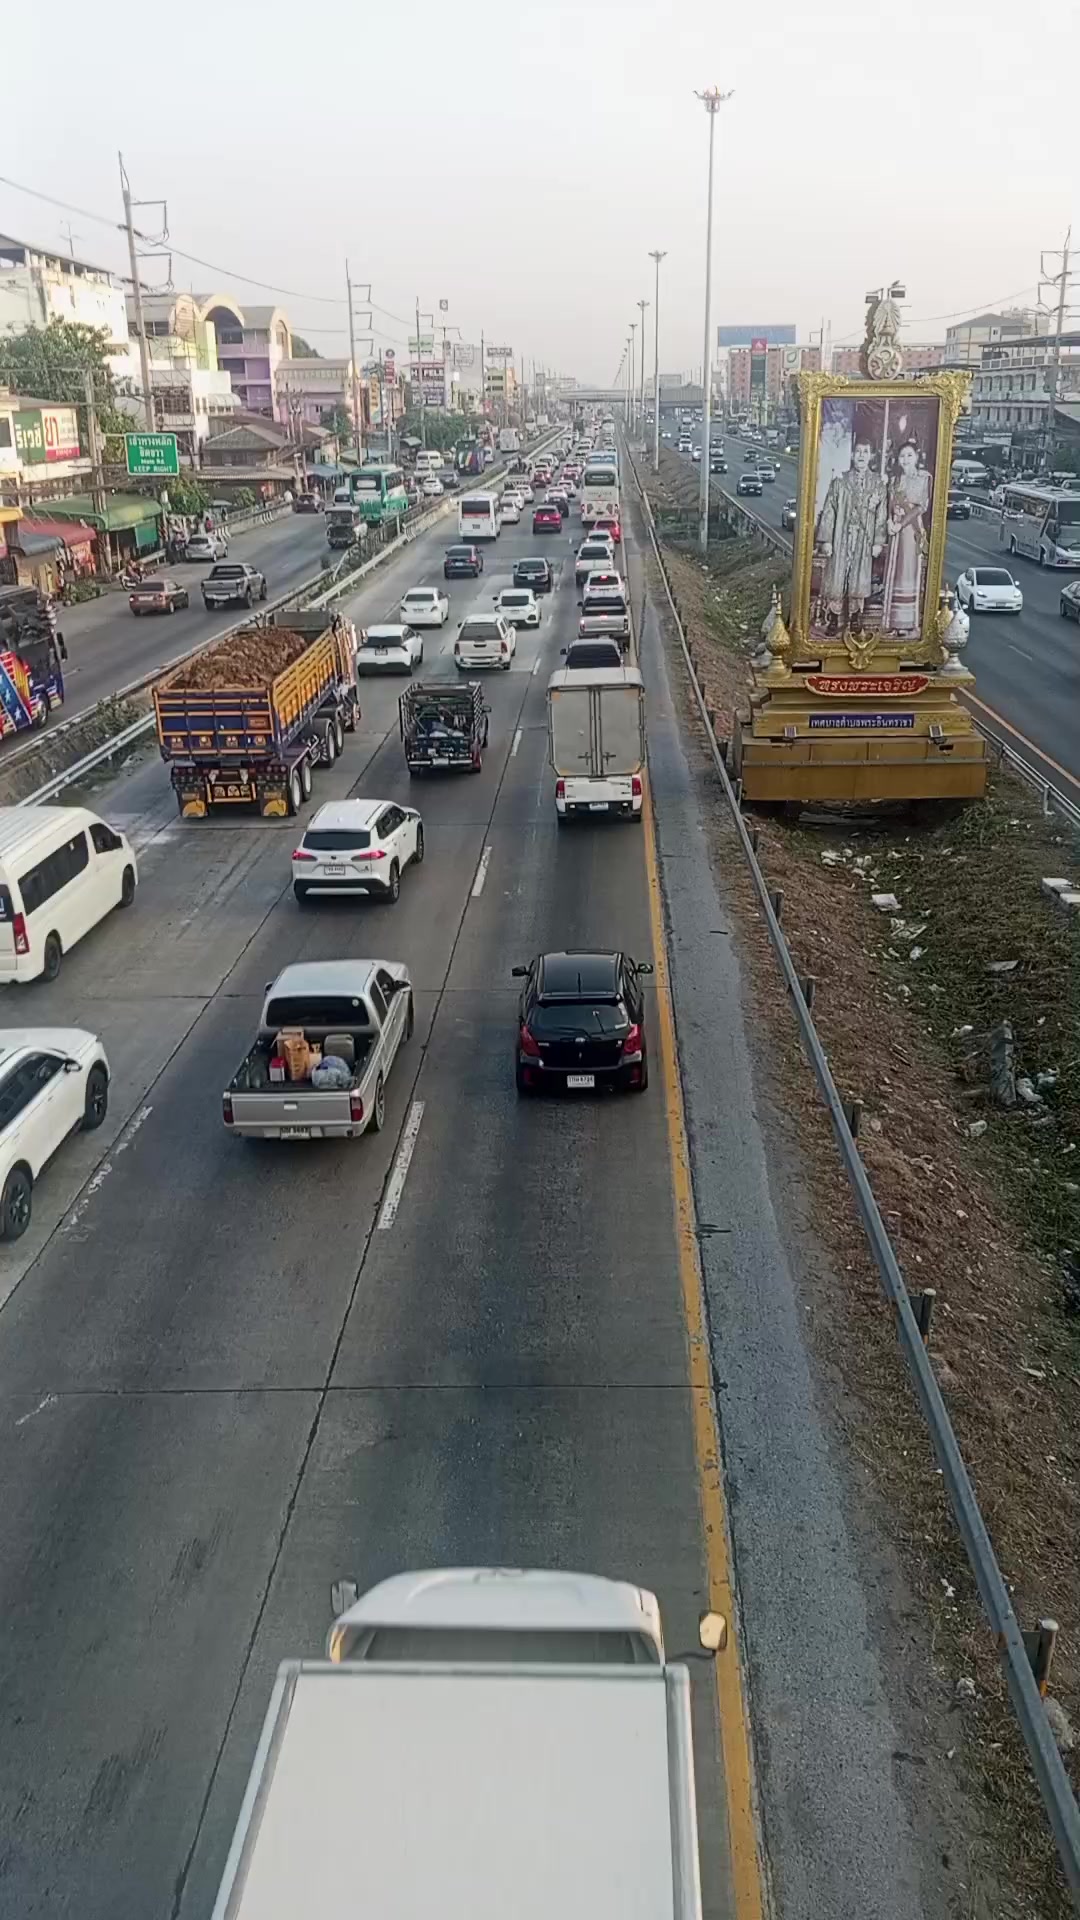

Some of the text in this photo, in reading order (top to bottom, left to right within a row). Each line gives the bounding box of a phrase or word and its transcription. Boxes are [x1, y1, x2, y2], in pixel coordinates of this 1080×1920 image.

[129, 434, 173, 446] เข้าทางหลัก
[134, 465, 173, 473] KEEP RIGHT
[818, 678, 917, 692] ทรงพระเจริญ
